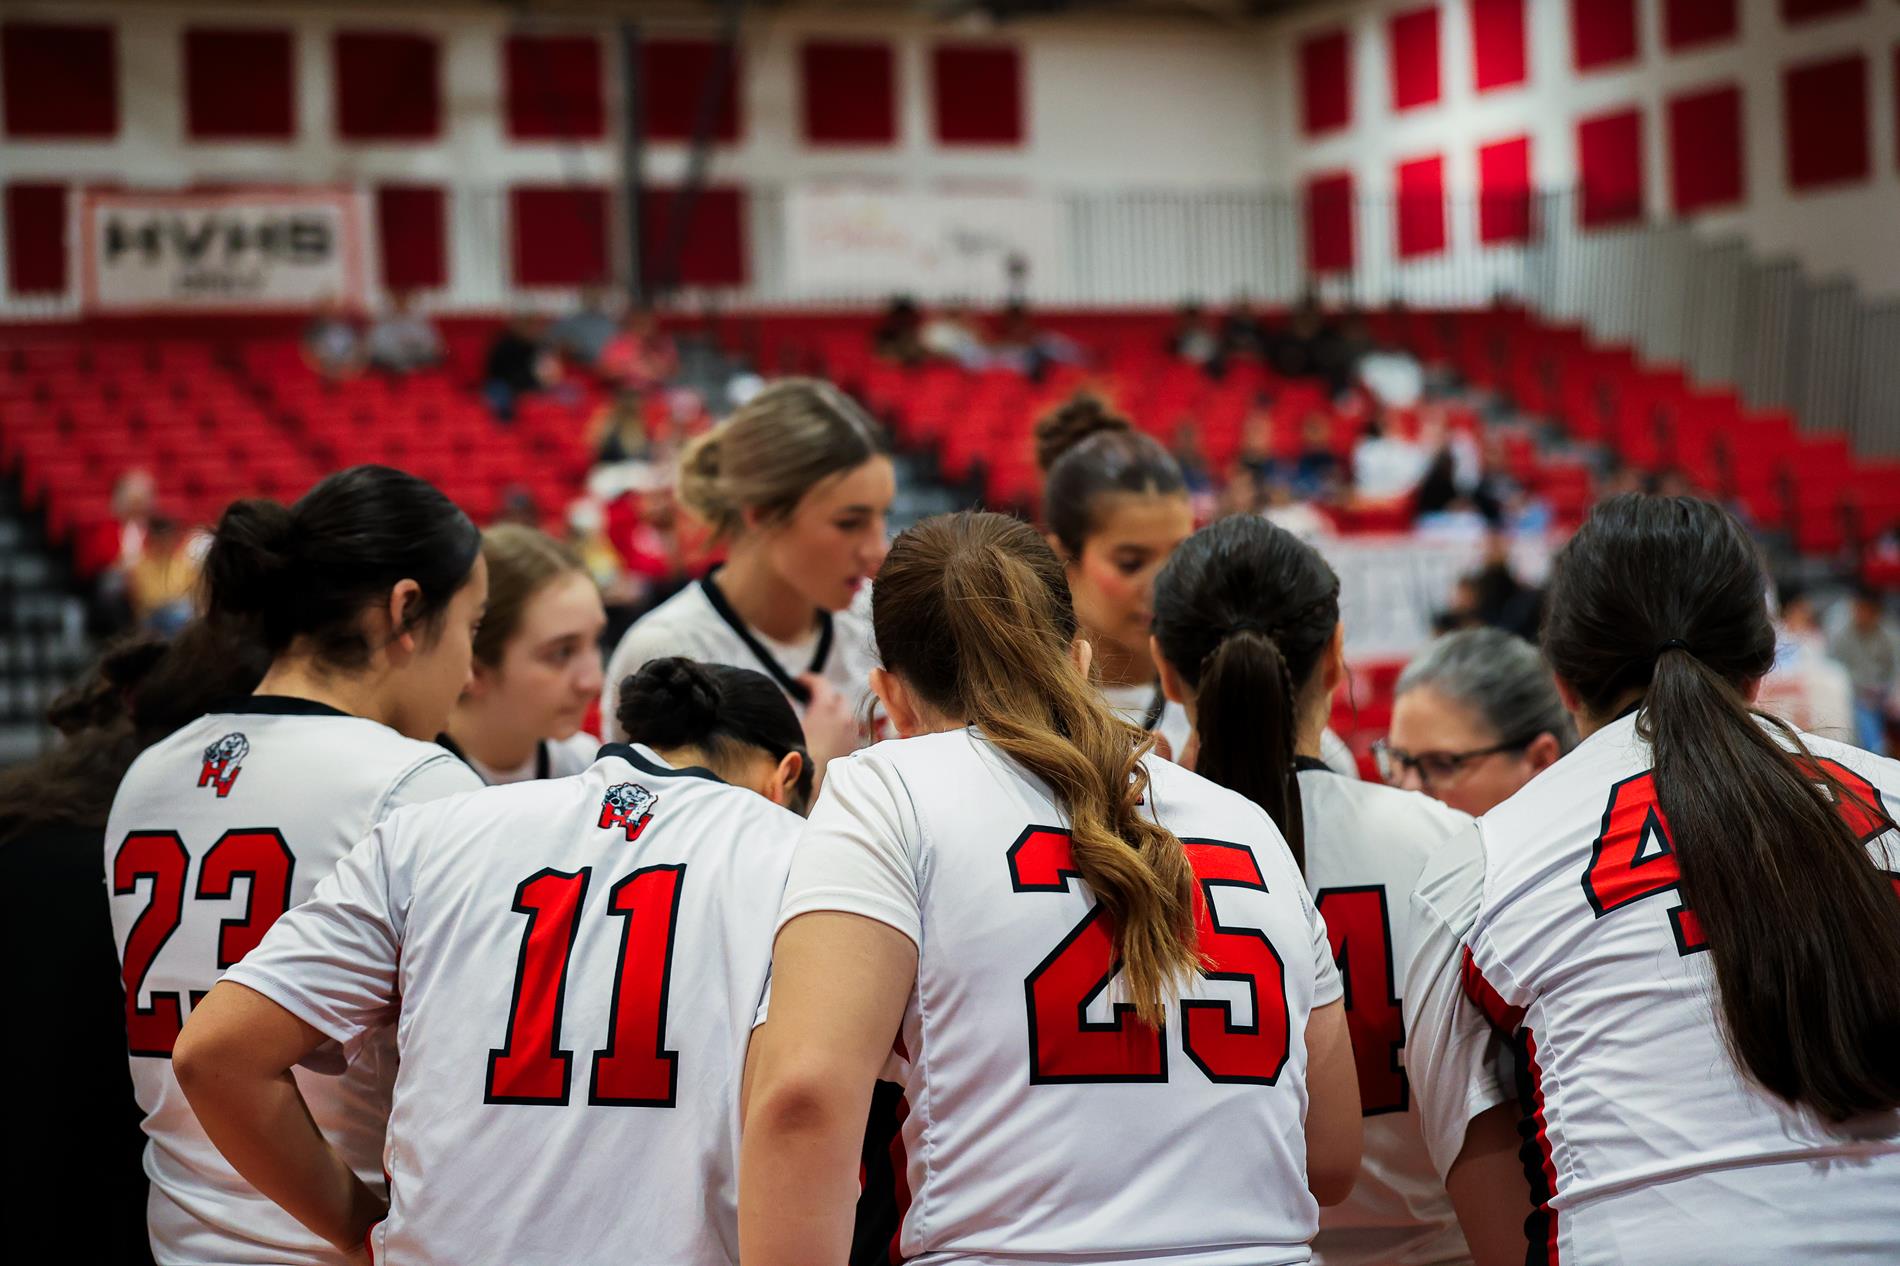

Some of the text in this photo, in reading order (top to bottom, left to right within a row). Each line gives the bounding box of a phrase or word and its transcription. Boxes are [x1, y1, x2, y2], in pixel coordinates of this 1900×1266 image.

[105, 213, 333, 263] HVHS
[113, 827, 296, 1058] 23
[483, 863, 687, 1108] 11
[1006, 824, 1290, 1087] 25
